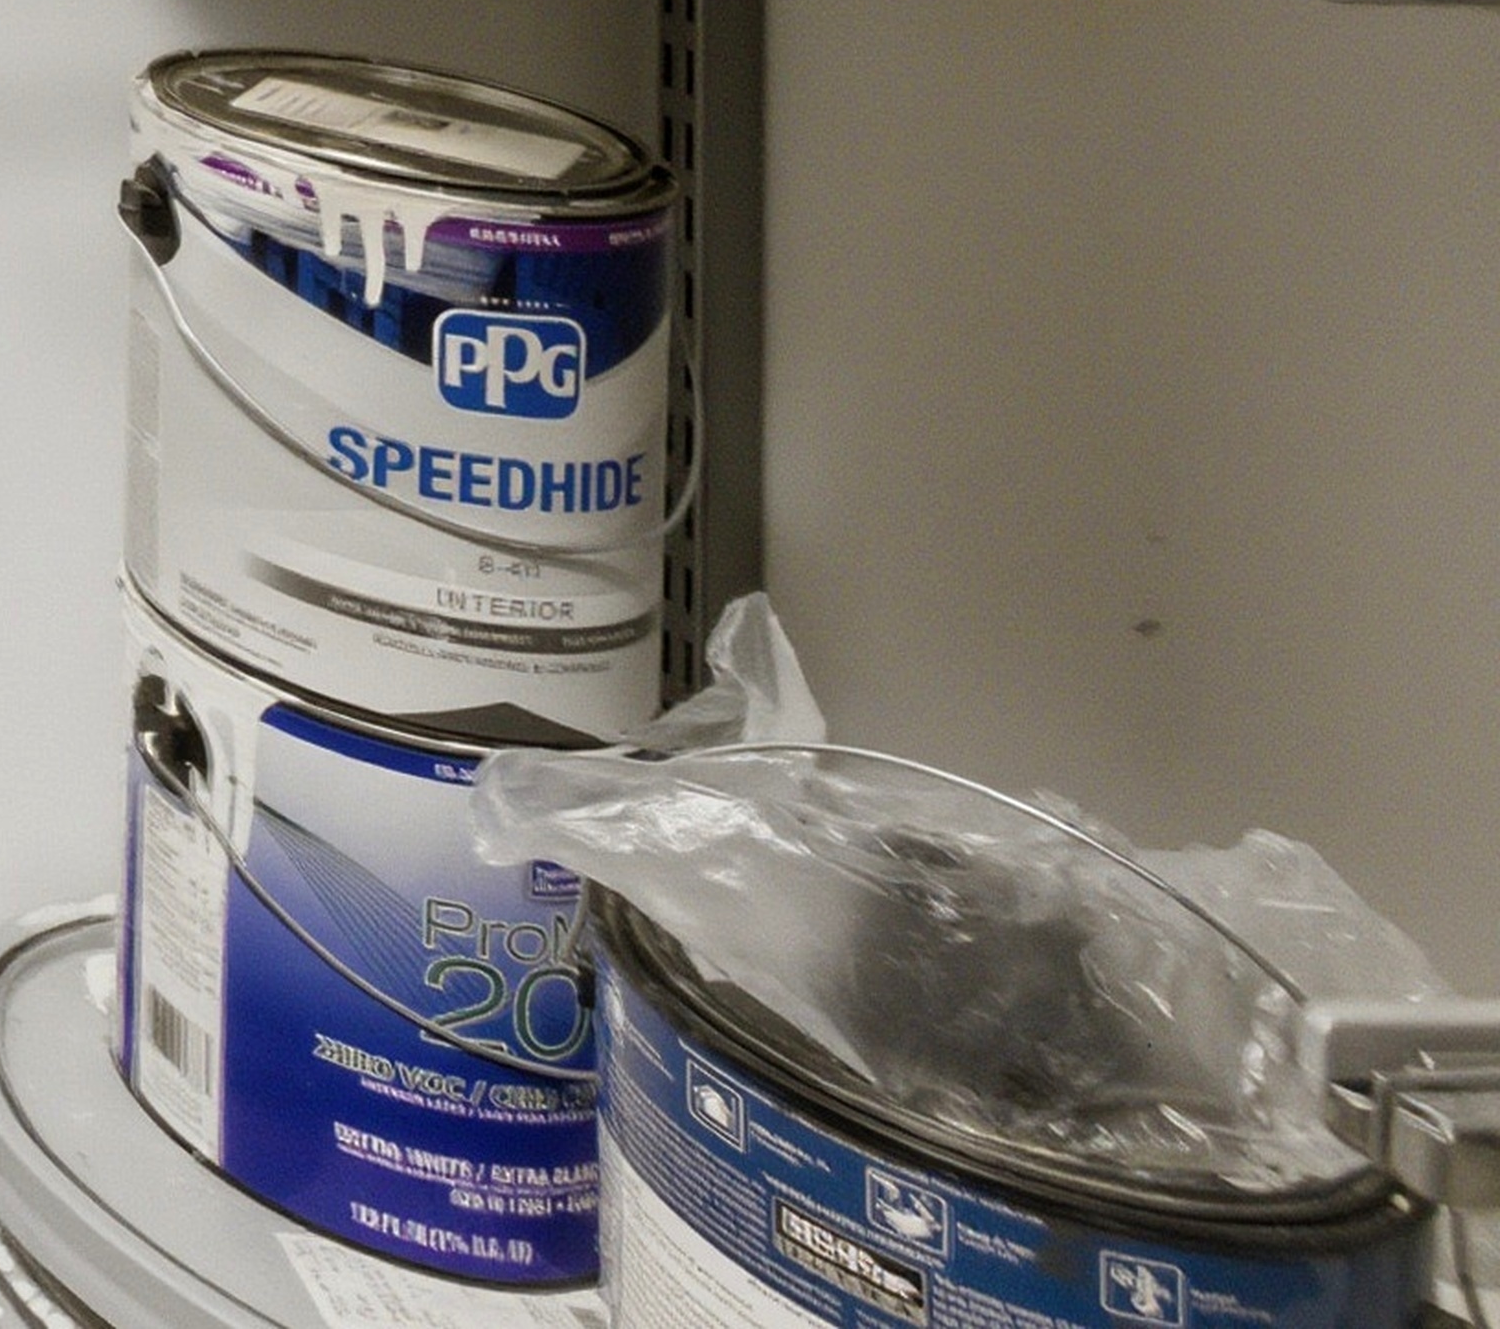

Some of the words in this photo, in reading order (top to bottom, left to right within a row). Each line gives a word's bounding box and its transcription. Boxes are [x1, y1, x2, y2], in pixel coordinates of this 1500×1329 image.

[443, 324, 578, 409] PPG
[326, 426, 646, 514] SPEEDHIDE
[436, 587, 576, 622] INTERIOR
[395, 1060, 467, 1102] VOC
[491, 1163, 549, 1187] EXTRA
